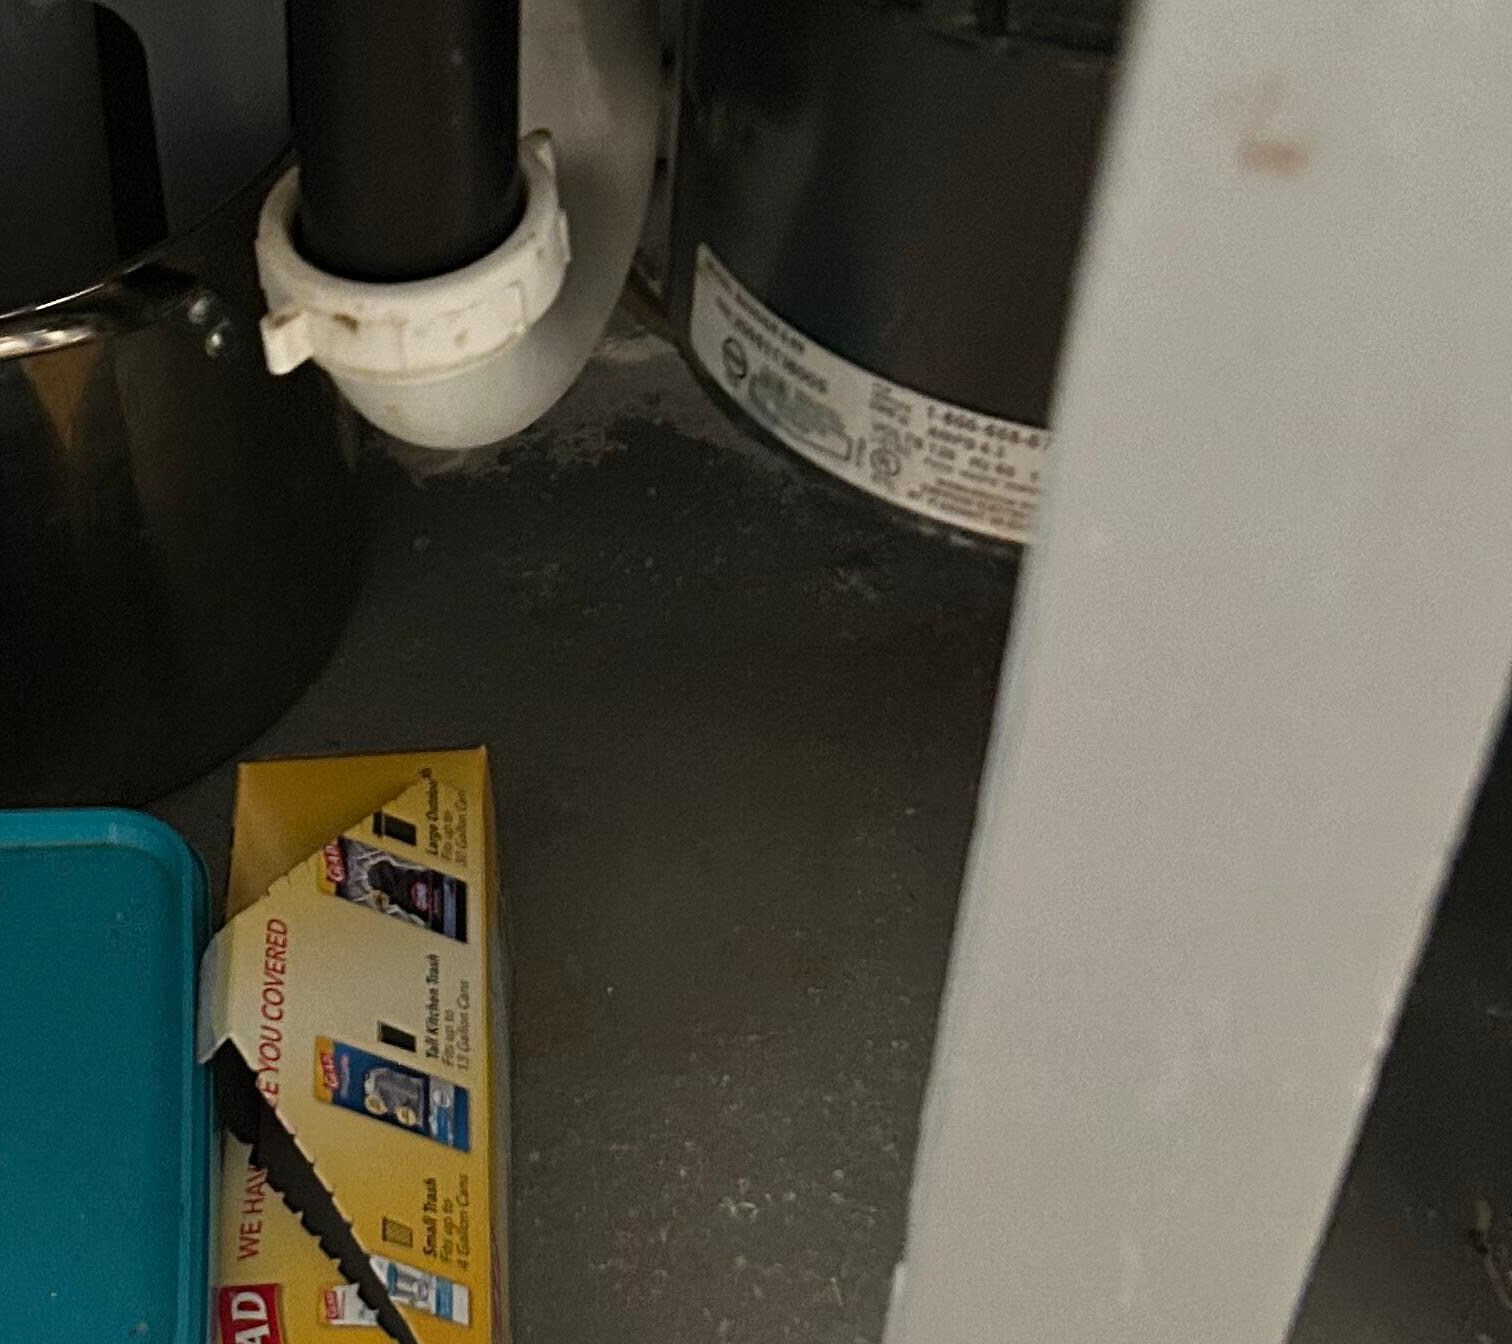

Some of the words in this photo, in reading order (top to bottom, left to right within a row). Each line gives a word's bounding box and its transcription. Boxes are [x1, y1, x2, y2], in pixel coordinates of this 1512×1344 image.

[260, 917, 288, 1022] COVERED
[425, 987, 440, 1035] Kitchen
[257, 1024, 283, 1076] YOU
[237, 1219, 263, 1262] WE
[422, 1215, 438, 1259] Small
